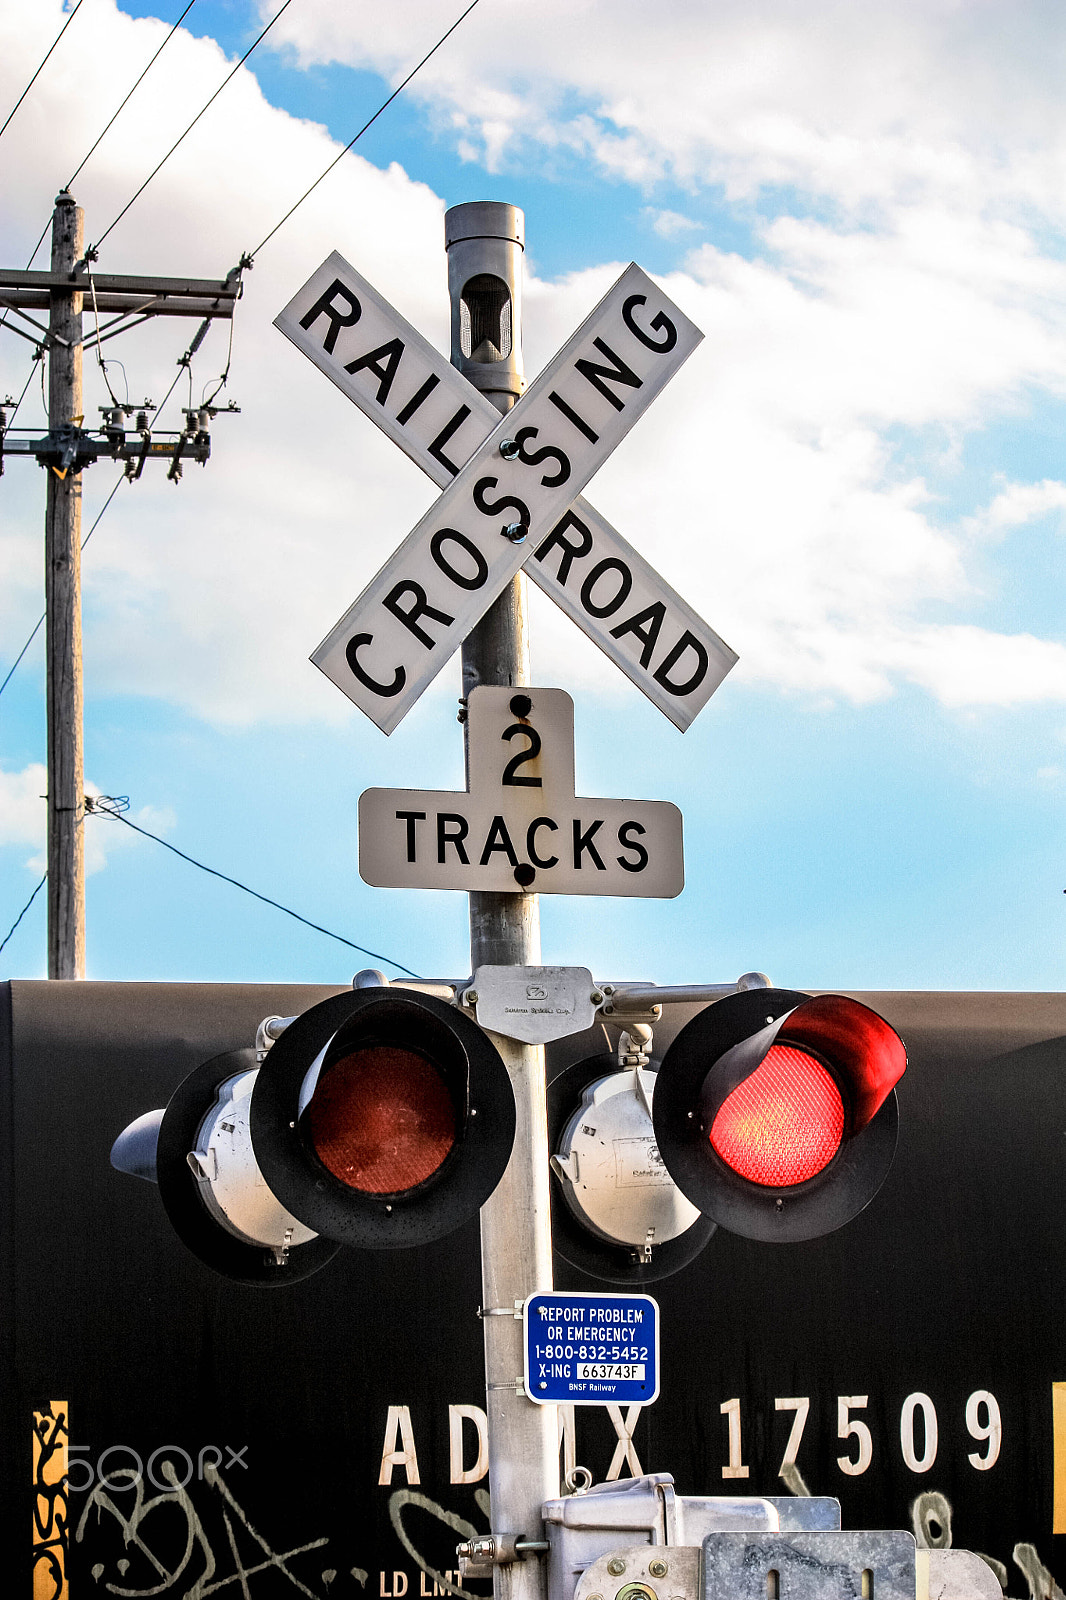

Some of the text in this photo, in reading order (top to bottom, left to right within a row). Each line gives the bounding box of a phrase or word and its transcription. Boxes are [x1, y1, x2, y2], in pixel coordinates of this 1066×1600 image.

[299, 278, 709, 697] RAIL ROAD
[345, 294, 678, 698] CROSSING
[501, 723, 543, 787] 2
[395, 810, 649, 873] TRACKS
[540, 1307, 643, 1324] REPORT PROBLEM
[547, 1326, 636, 1342] OR EMERGENCY
[535, 1344, 649, 1361] 1-800-832-5452
[538, 1363, 639, 1379] X-ING 663743F
[568, 1383, 617, 1393] BNSF Railway
[719, 1389, 1003, 1479] 17509
[379, 1570, 409, 1598] LD
